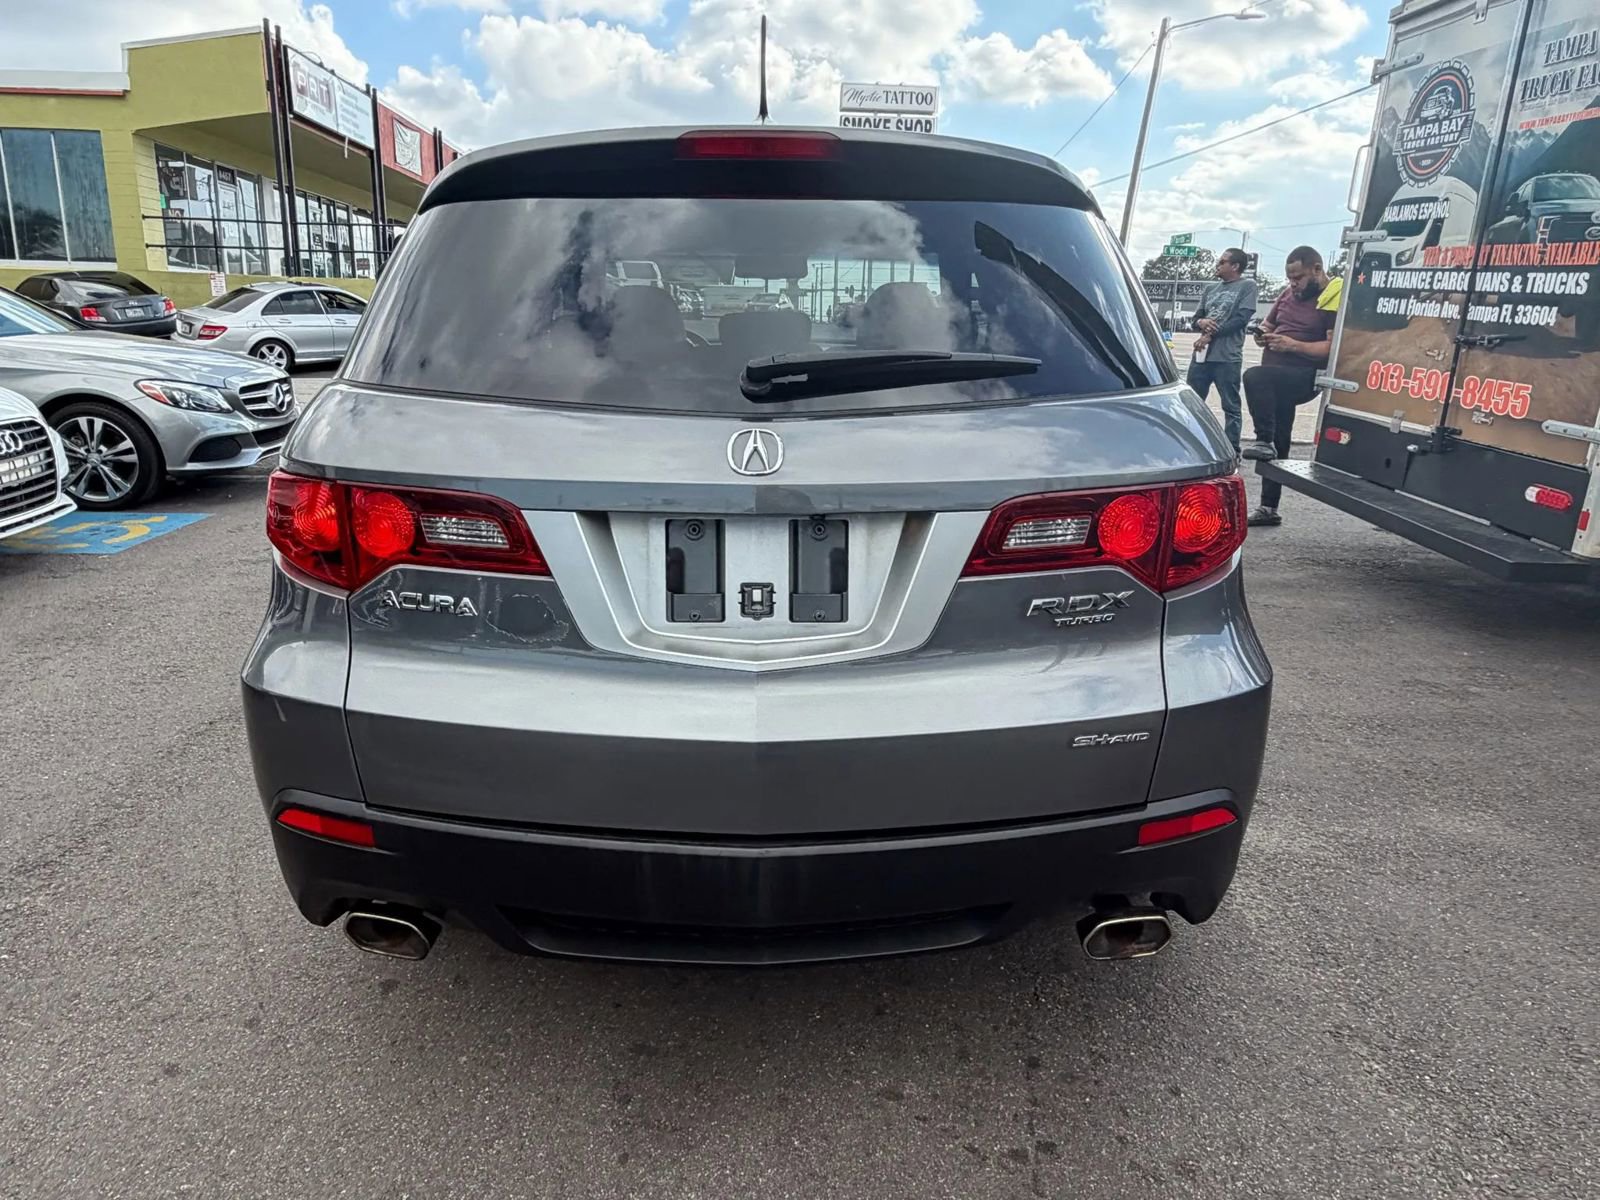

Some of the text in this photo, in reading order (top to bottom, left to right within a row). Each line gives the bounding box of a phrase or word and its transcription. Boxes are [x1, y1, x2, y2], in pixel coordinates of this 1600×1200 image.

[1543, 28, 1600, 67] TAMPA
[1520, 61, 1600, 103] TRUCK FA
[844, 88, 933, 106] Mystic TATTOO
[843, 117, 932, 133] SMOKE SHOP
[1402, 116, 1467, 141] TAMPA BAY
[1403, 131, 1460, 149] TRUCK FACTORY
[1383, 203, 1419, 222] HABLAMOS
[1169, 246, 1188, 256] Wood
[1489, 243, 1541, 266] FINANCING
[1371, 270, 1388, 288] WE
[1387, 271, 1433, 290] FINANCE
[1475, 271, 1511, 293] VANS
[1511, 275, 1523, 293] &
[1525, 271, 1590, 295] TRUCKS
[1376, 297, 1400, 315] 8501
[1399, 298, 1408, 315] N
[1406, 297, 1441, 318] Florida
[1440, 301, 1461, 320] Ave.
[1467, 302, 1500, 323] ampa
[1514, 304, 1559, 326] 33604
[377, 589, 479, 617] ACURA
[1026, 590, 1135, 617] RDX
[1054, 613, 1116, 627] TURBO
